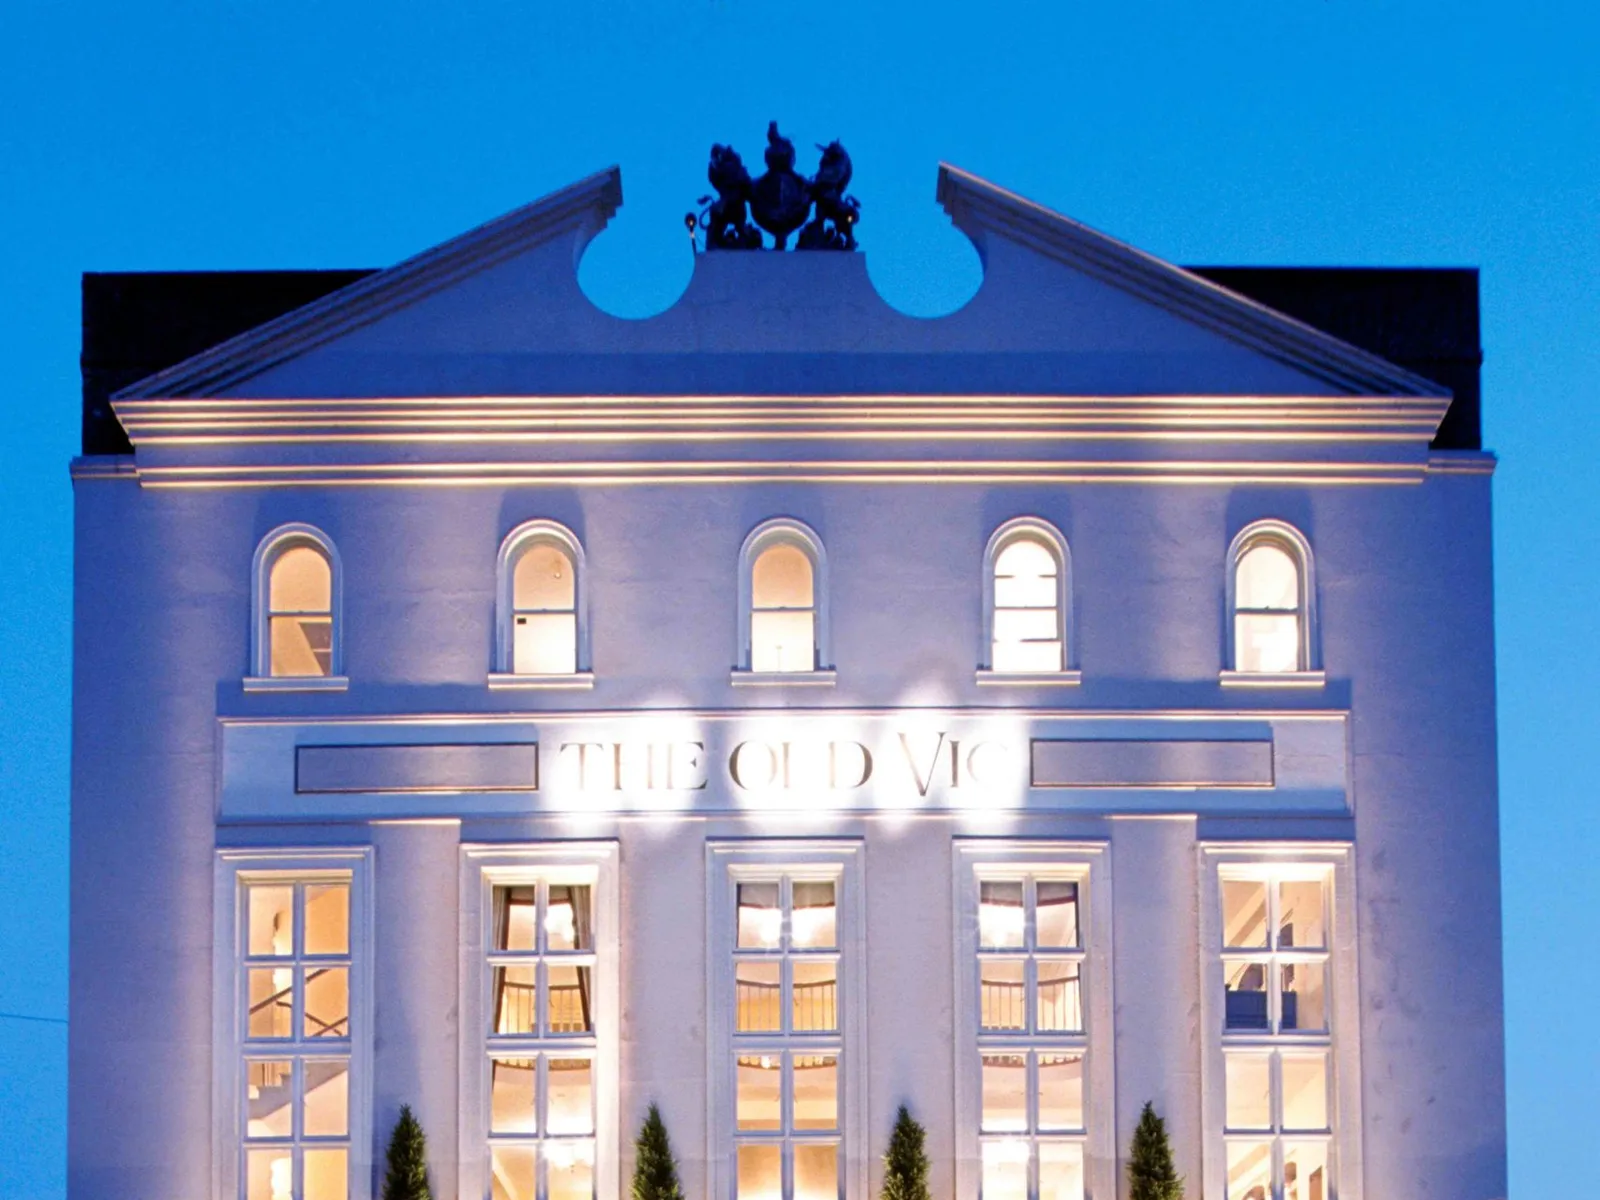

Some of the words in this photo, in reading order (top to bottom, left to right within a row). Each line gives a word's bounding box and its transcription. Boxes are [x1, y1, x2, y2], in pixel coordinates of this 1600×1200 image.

[561, 741, 706, 791] THE
[728, 740, 873, 790] OLD
[897, 732, 1008, 797] VIC
